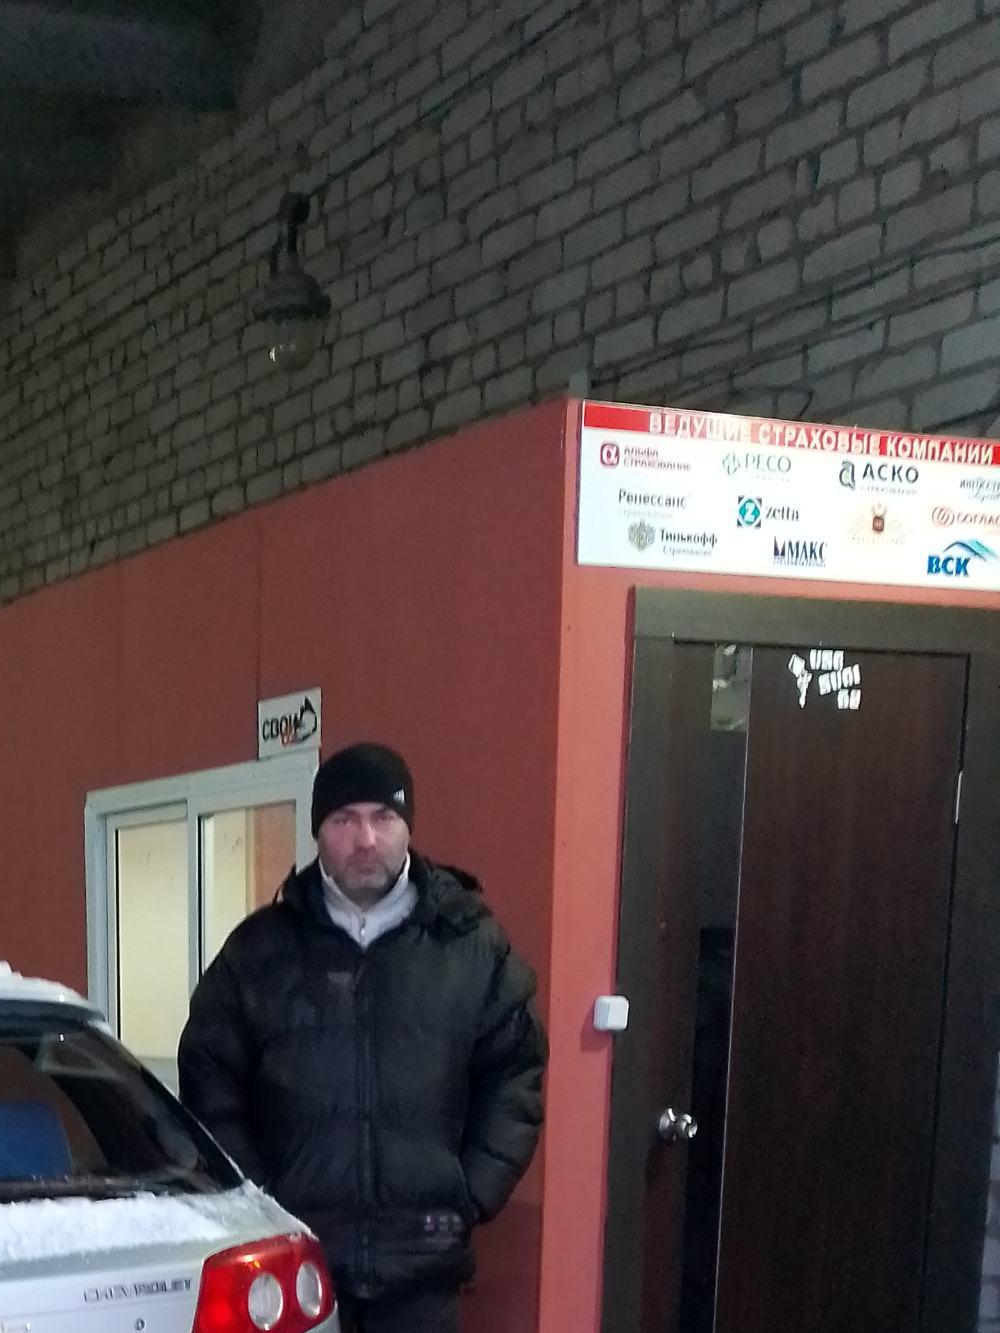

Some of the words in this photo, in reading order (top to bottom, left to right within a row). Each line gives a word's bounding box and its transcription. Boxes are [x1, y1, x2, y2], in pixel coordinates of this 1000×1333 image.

[649, 411, 751, 443] ВЕДУЩИЕ
[758, 423, 881, 456] СТРАХОВЫЕ
[886, 434, 994, 465] КОМПАНИИ
[745, 452, 792, 473] РЕСО
[862, 461, 920, 484] АСКО
[618, 487, 688, 510] Ренессанс
[660, 528, 718, 549] Тинькофф
[926, 553, 972, 577] ВСК
